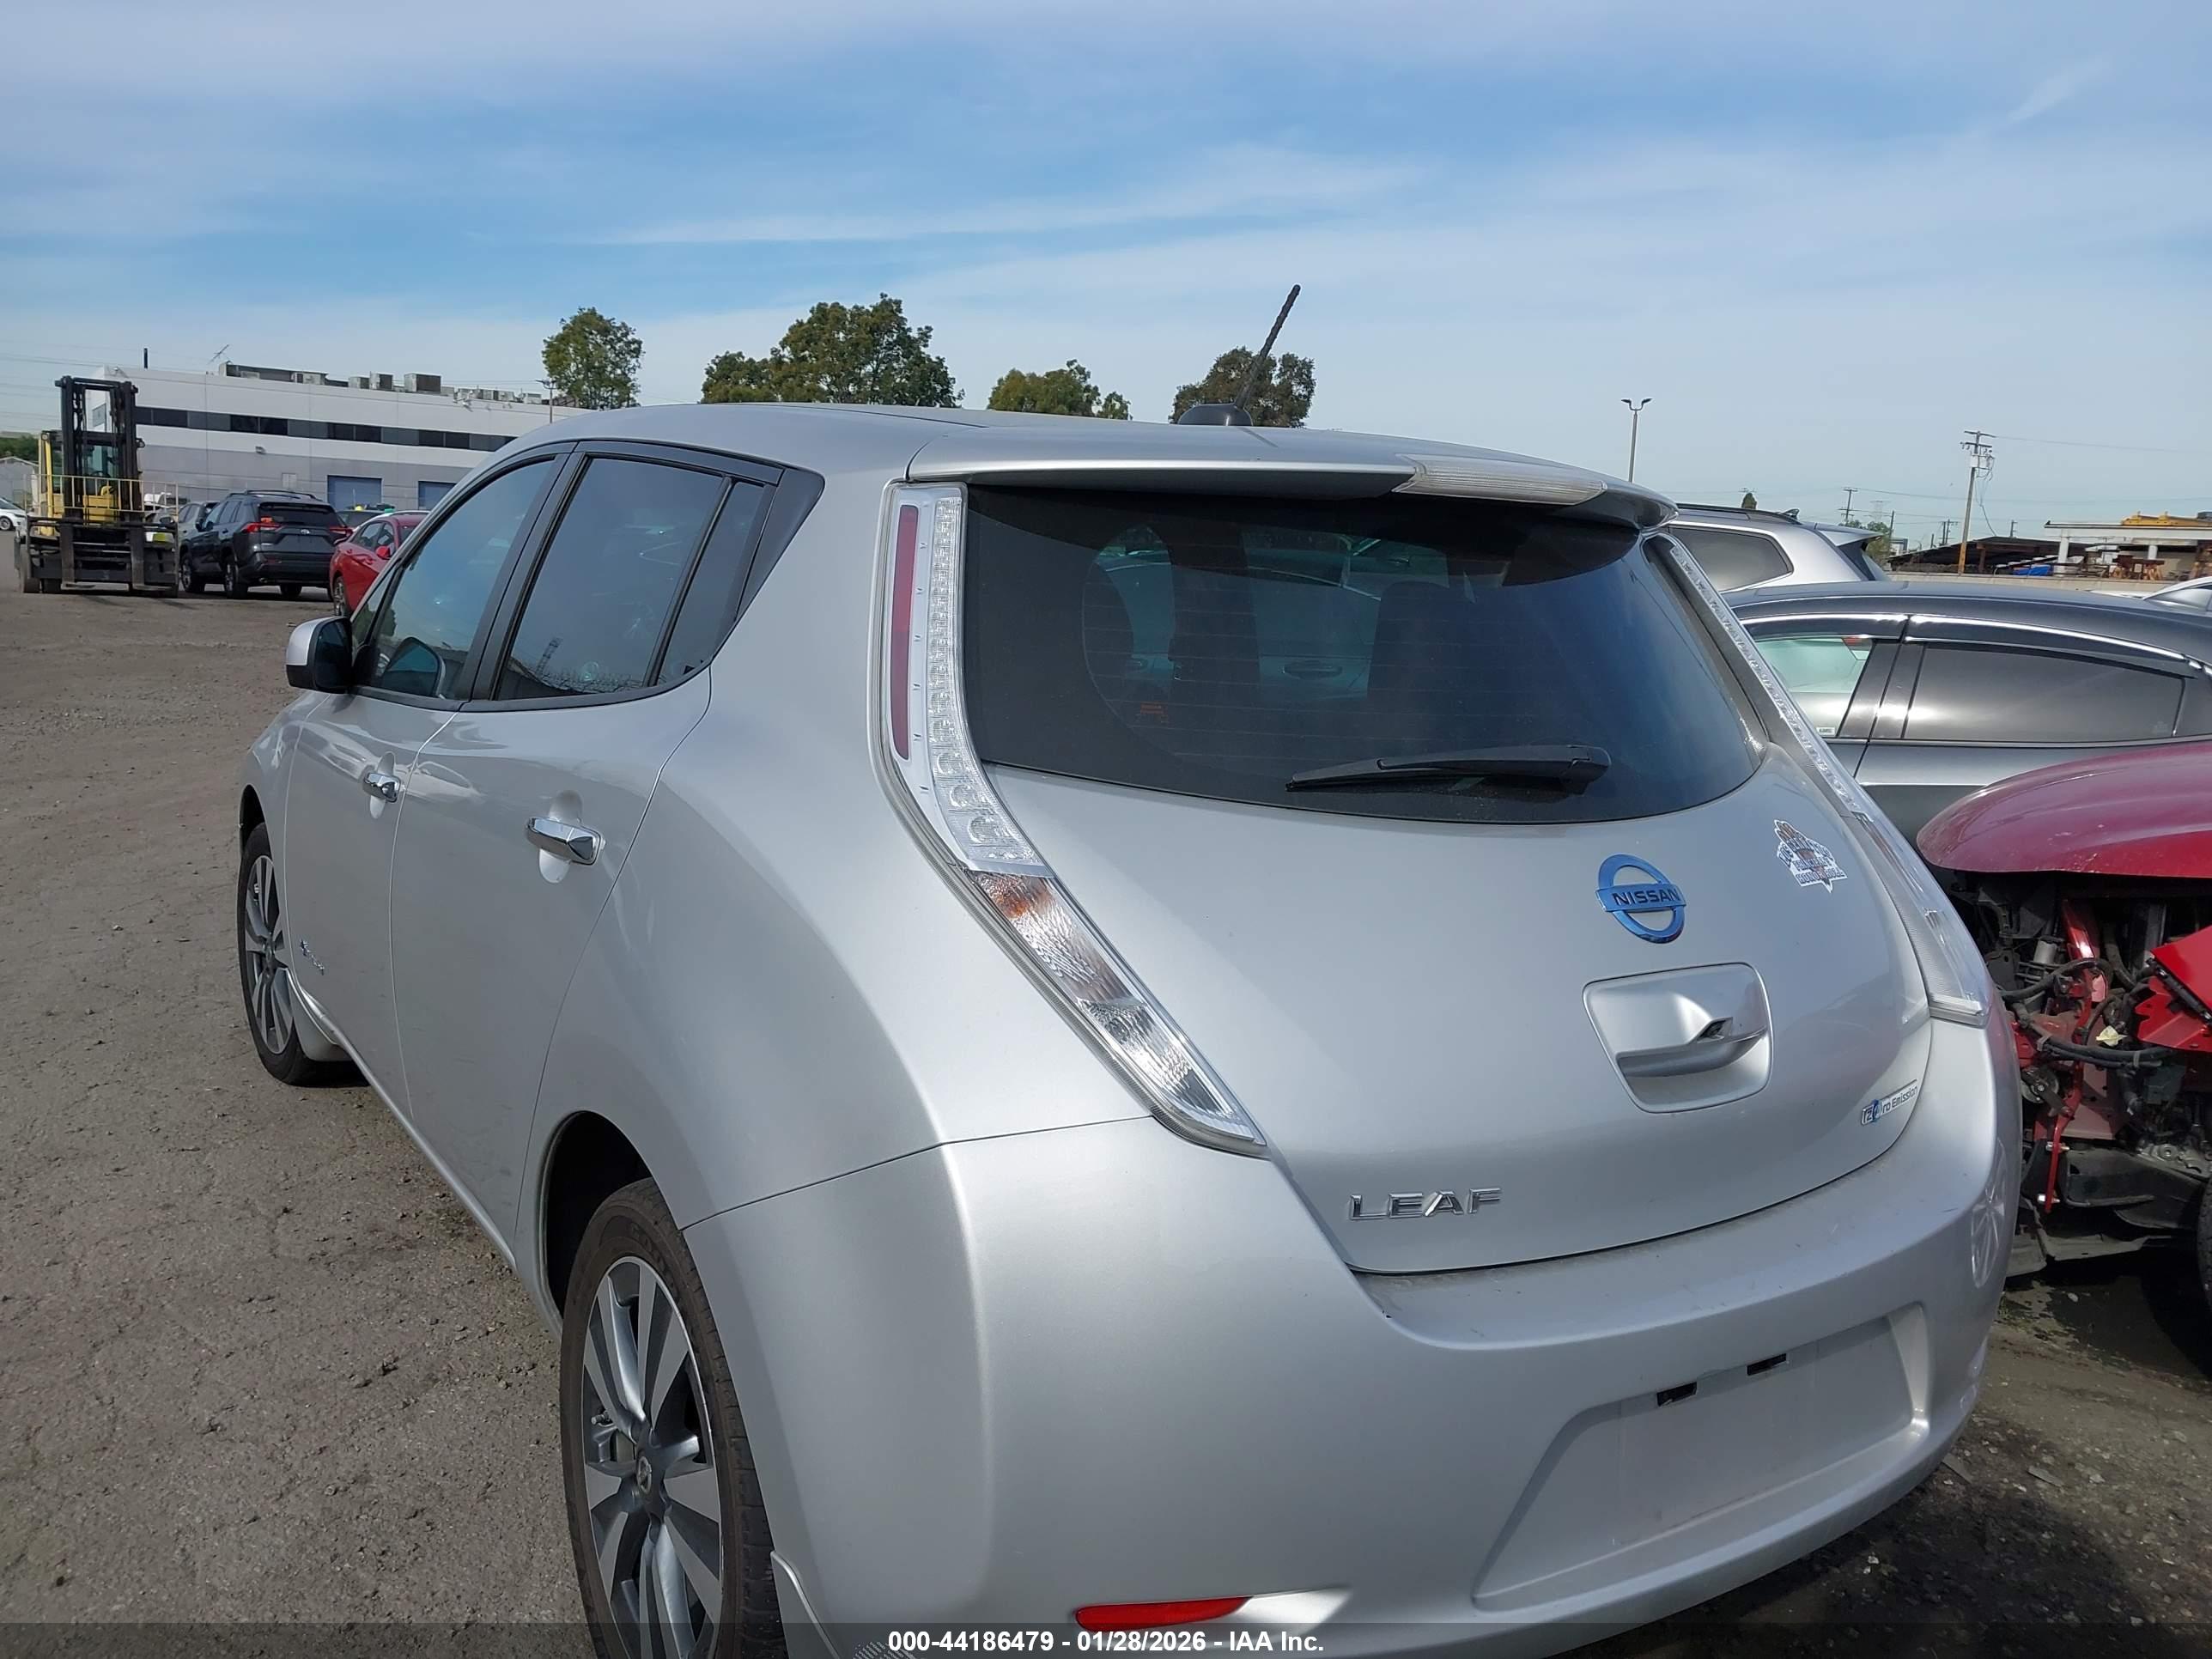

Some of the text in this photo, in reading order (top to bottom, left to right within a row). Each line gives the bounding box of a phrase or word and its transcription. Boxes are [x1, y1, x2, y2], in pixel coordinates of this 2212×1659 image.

[1795, 871, 1826, 884] HONOR
[1612, 888, 1680, 906] NISSAN
[1892, 1085, 1917, 1108] Emission
[1350, 1188, 1502, 1220] LEAF
